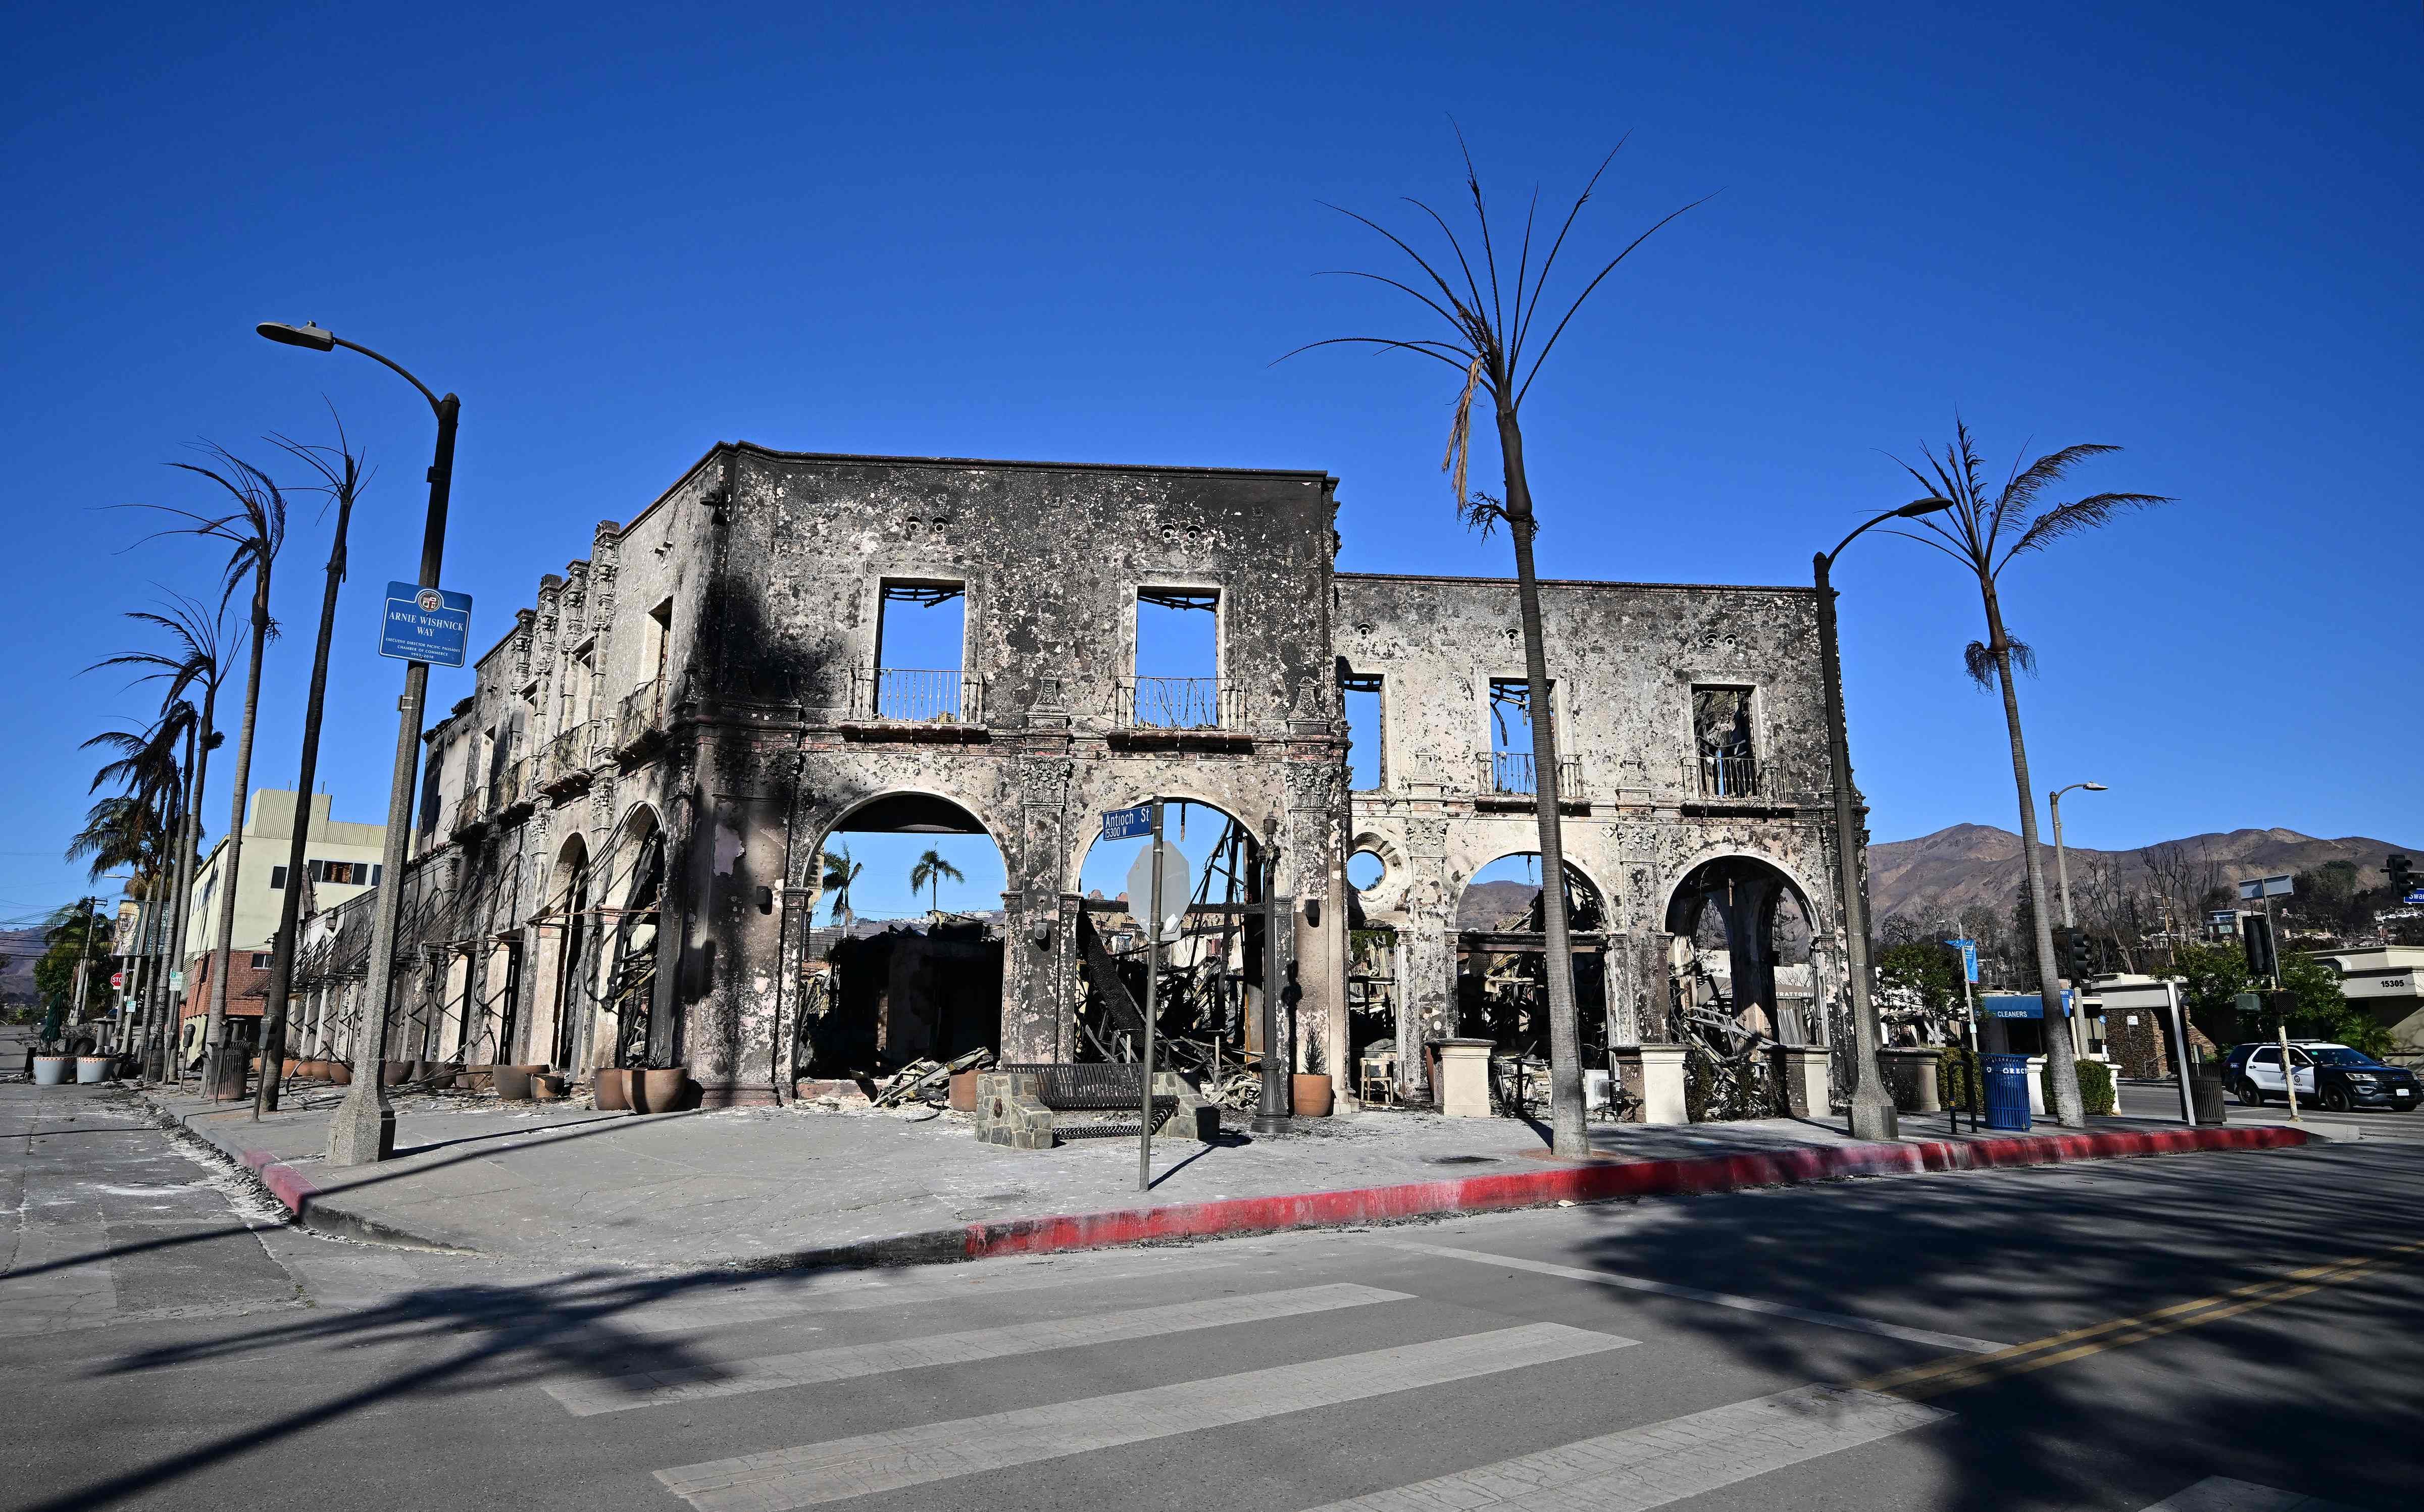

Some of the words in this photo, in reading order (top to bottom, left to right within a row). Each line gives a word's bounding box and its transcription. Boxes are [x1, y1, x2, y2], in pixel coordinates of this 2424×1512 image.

[389, 611, 417, 623] ARNIE
[420, 616, 464, 631] WISHNICK
[417, 627, 434, 637] WAY
[1105, 811, 1134, 828] Antioch
[1141, 807, 1149, 822] St
[1105, 827, 1120, 838] 15300
[1122, 826, 1127, 836] W
[2380, 979, 2404, 987] 15305
